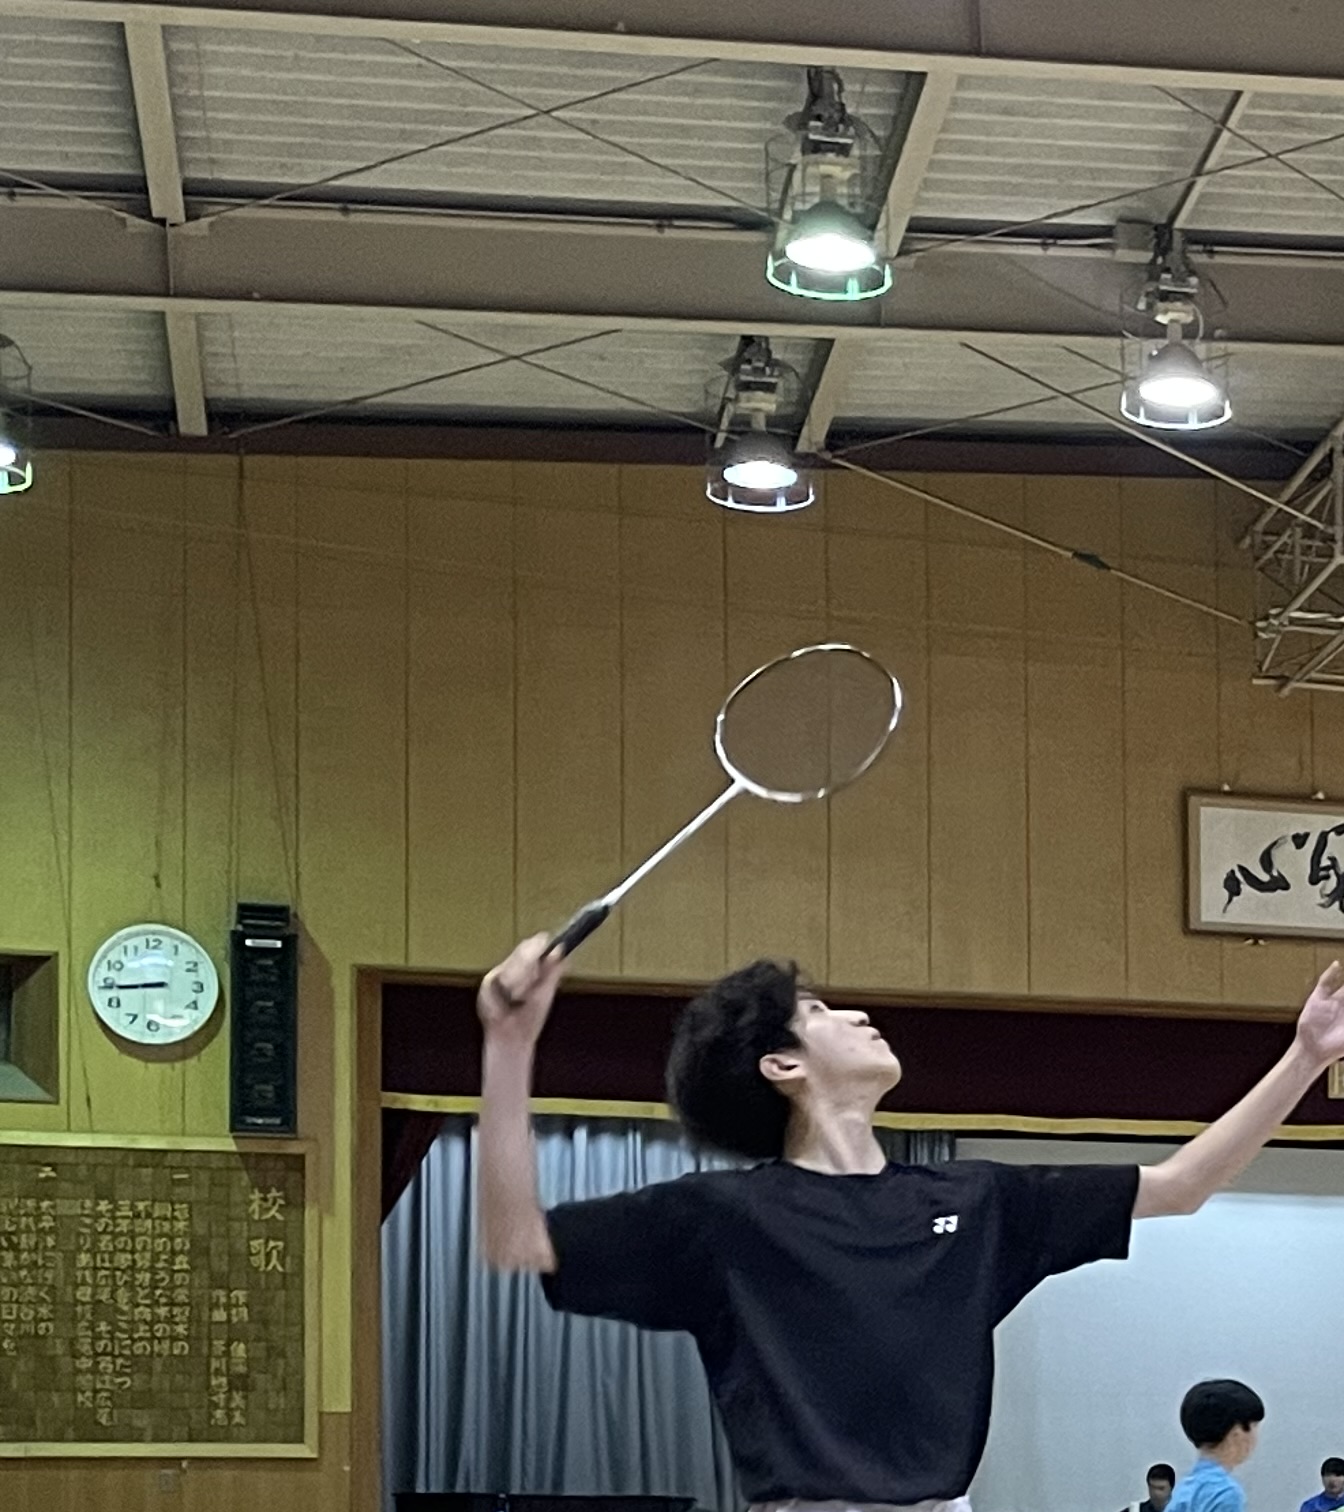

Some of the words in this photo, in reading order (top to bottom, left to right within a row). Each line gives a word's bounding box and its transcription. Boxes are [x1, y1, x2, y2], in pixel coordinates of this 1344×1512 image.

[144, 937, 164, 951] 12
[122, 944, 139, 958] 11
[106, 959, 125, 973] 10
[185, 960, 199, 973] 2
[192, 980, 205, 994] 3
[107, 996, 121, 1009] 8
[184, 999, 199, 1012] 4
[125, 1012, 139, 1025] 7
[146, 1020, 160, 1033] 6
[249, 1187, 286, 1273] 校歌
